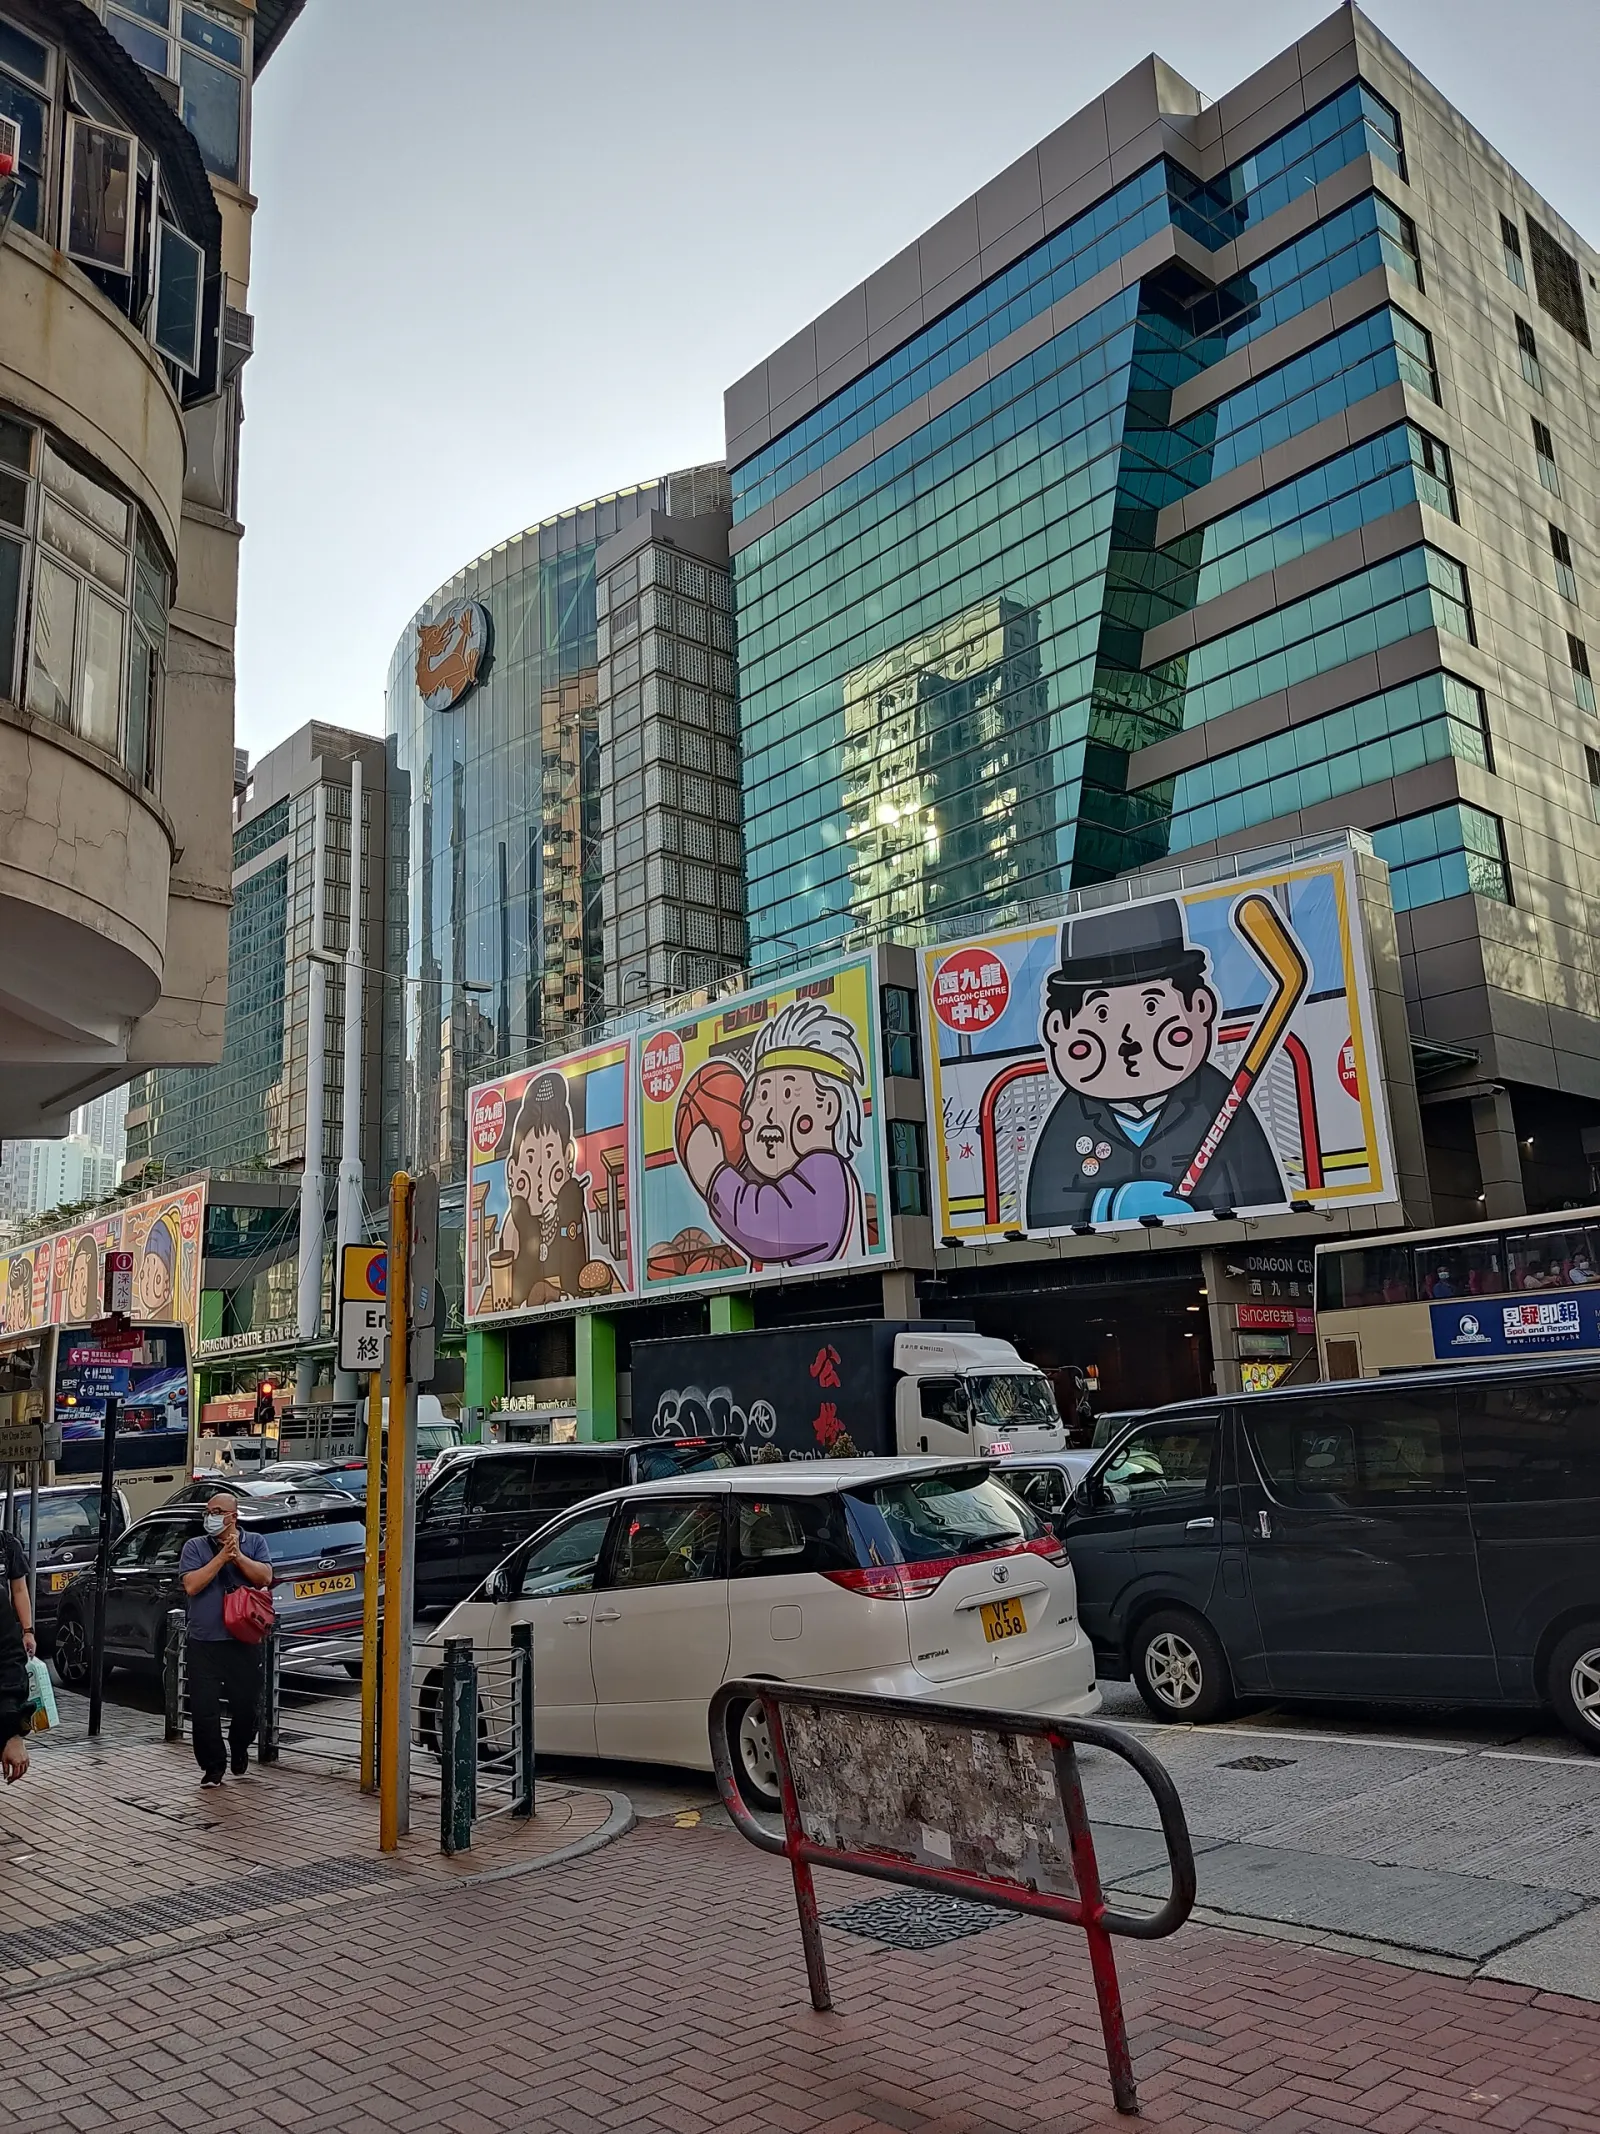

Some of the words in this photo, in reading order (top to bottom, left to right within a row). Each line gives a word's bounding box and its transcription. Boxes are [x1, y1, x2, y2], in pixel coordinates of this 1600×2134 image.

[938, 963, 1002, 996] 西九龍
[951, 999, 995, 1025] 中心
[644, 1043, 681, 1072] 西九龍
[650, 1073, 675, 1097] 中心
[475, 1101, 503, 1126] 西九龍
[478, 1127, 497, 1148] 中心
[1194, 1085, 1243, 1170] CHEEKY
[1249, 1257, 1294, 1272] DRAGON
[116, 1272, 131, 1310] 深水埗
[1503, 1301, 1579, 1327] 見疑即報
[201, 1336, 231, 1353] DRAGON
[231, 1331, 262, 1349] CENTRE
[1506, 1328, 1527, 1336] Spot
[1547, 1324, 1578, 1332] Report
[357, 1335, 379, 1361] 終
[62, 1379, 80, 1387] EPS
[500, 1395, 536, 1412] 美心西餅
[997, 1443, 1012, 1453] TAXI
[300, 1583, 316, 1596] XT
[319, 1577, 352, 1593] 9462
[992, 1601, 1010, 1621] VF
[989, 1617, 1022, 1642] 1038
